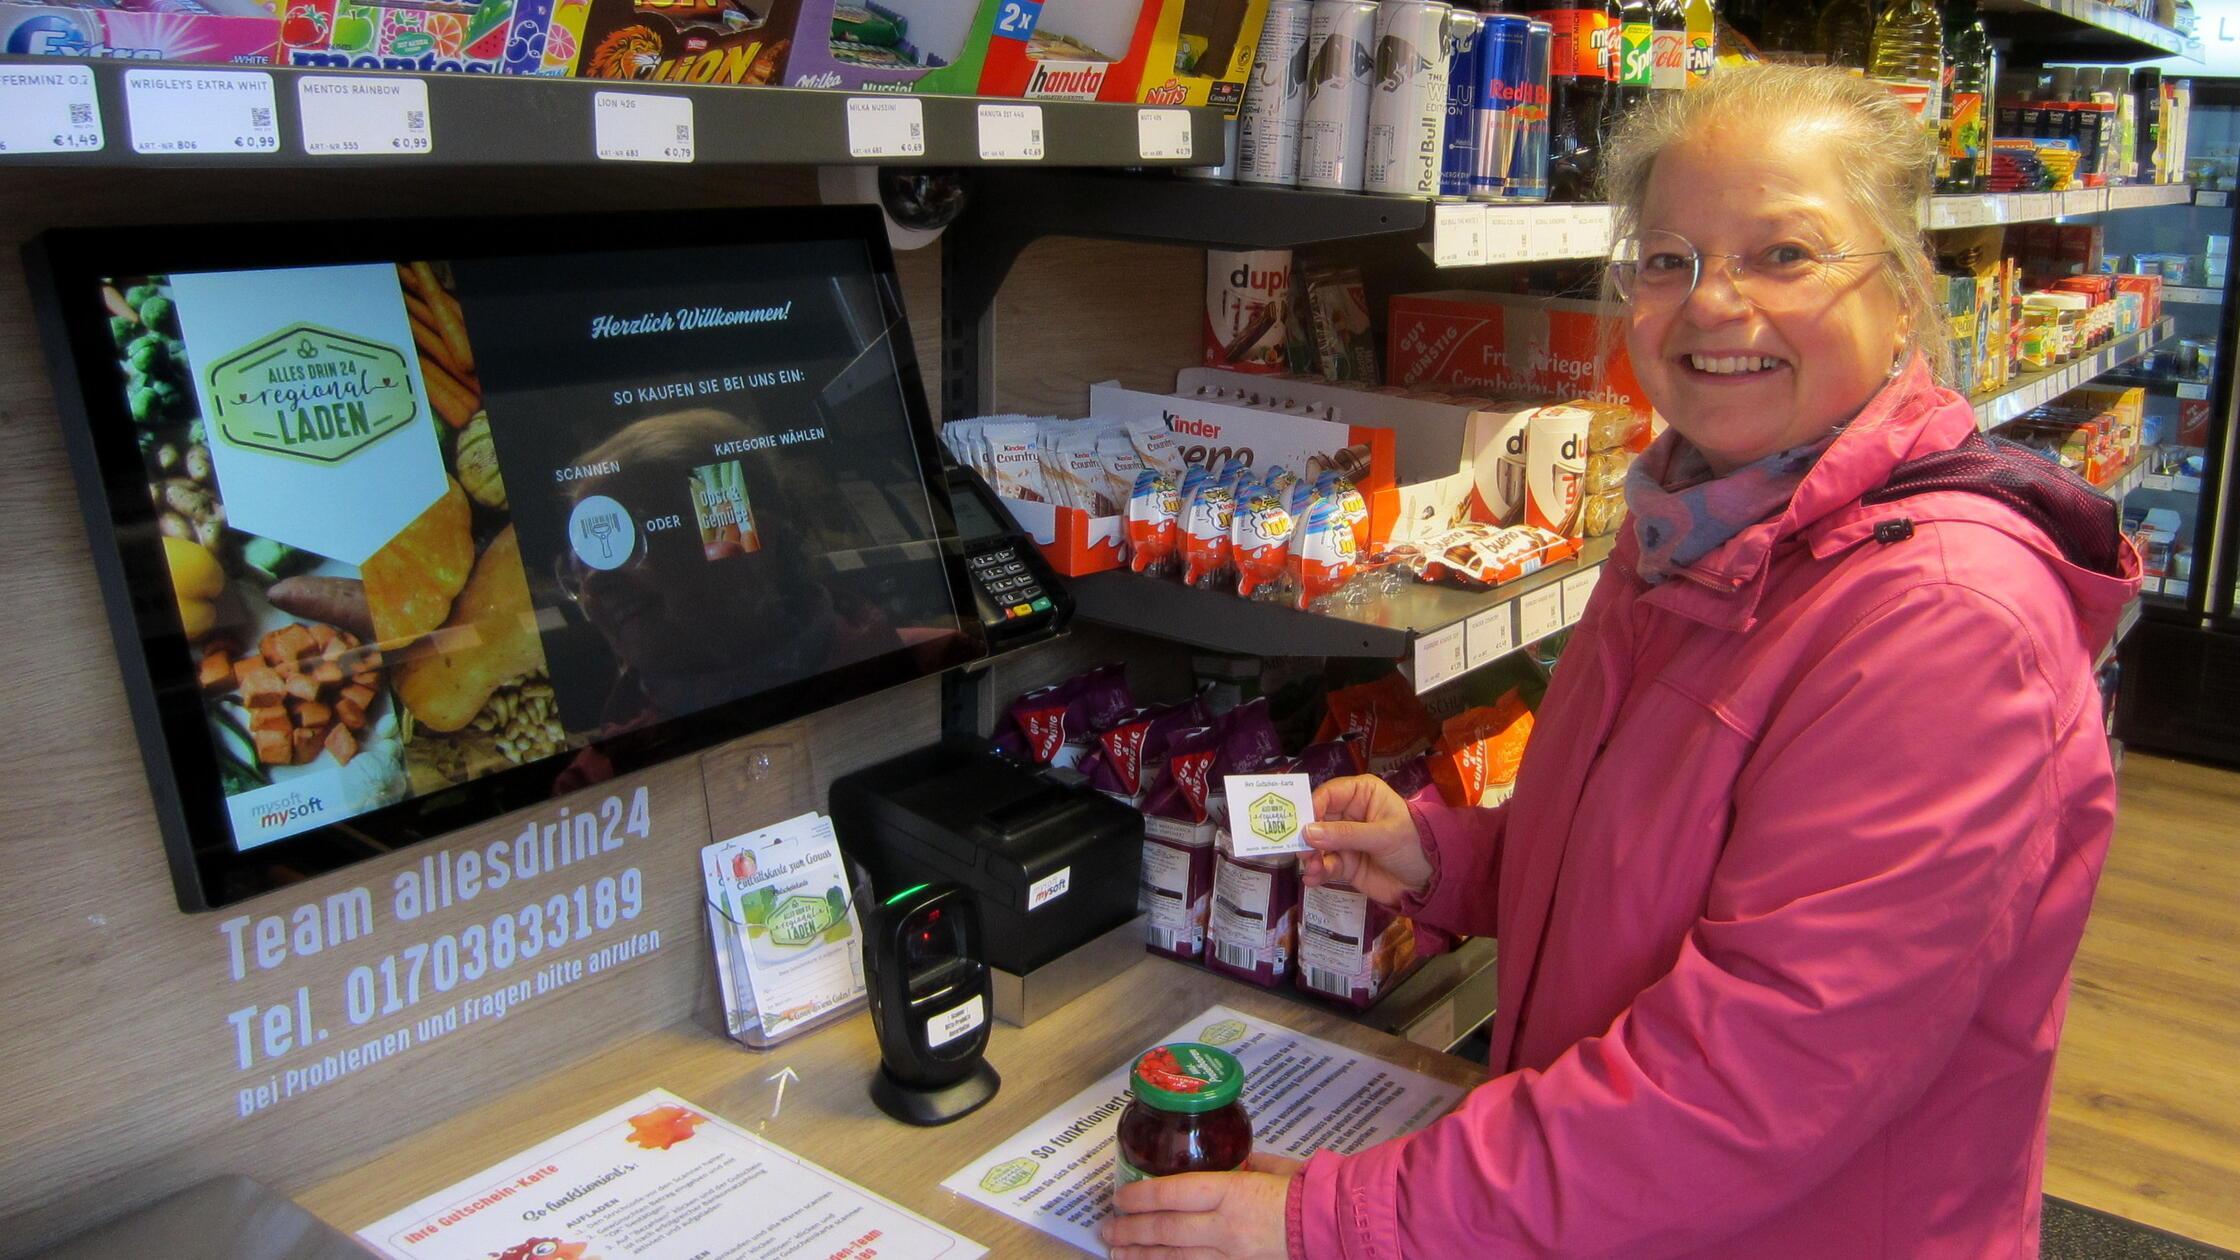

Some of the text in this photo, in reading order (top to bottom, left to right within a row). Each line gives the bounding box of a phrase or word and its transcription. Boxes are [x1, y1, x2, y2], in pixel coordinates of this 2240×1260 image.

[1000, 3, 1031, 30] 2x
[131, 79, 268, 91] WRIGLEYS EXTRA WHIT
[303, 84, 400, 95] MENTOS RAINBOW
[1032, 65, 1102, 93] hanuta
[597, 99, 618, 109] LION
[850, 104, 897, 112] MILKA NUSSINI
[68, 134, 98, 147] 1,49
[177, 141, 197, 150] 806
[247, 136, 275, 148] 0,99
[343, 142, 359, 150] 555
[403, 138, 428, 149] 0,99
[672, 147, 692, 158] 0,79
[591, 301, 792, 340] Herzlich Willkommen!
[1400, 321, 1425, 351] GUT
[268, 360, 357, 384] ALLES DRIN 24
[250, 369, 376, 411] regional
[613, 368, 806, 406] SO KAUFEN SIE BEI UNS EIN:
[276, 402, 371, 445] LADEN
[714, 427, 825, 456] KATEGORIE WÄHLEN
[996, 453, 1039, 464] Country
[556, 460, 621, 482] SCANNEN
[700, 486, 741, 507] Obst &
[646, 514, 682, 532] ODER
[702, 506, 750, 530] Gemüse
[1485, 531, 1519, 554] bueno
[1113, 734, 1123, 757] GUT
[261, 797, 324, 828] mysoft
[1264, 821, 1286, 834] LADEN
[220, 785, 652, 981] Team allesdrin24
[1035, 878, 1067, 902] mysoft
[787, 922, 816, 940] LADEN
[228, 867, 643, 1070] Tel. 01703833189
[239, 1076, 279, 1117] Bei
[285, 1028, 411, 1098] Problemen
[418, 1006, 457, 1043] und
[536, 957, 583, 994] bitte
[589, 929, 661, 976] anrufen
[1031, 1095, 1128, 1159] So funktioniert
[1054, 1169, 1069, 1180] sich
[405, 1164, 559, 1245] Ihre Gutschein-Karte
[522, 1208, 547, 1222] So
[566, 1198, 620, 1229] AUFLADEN
